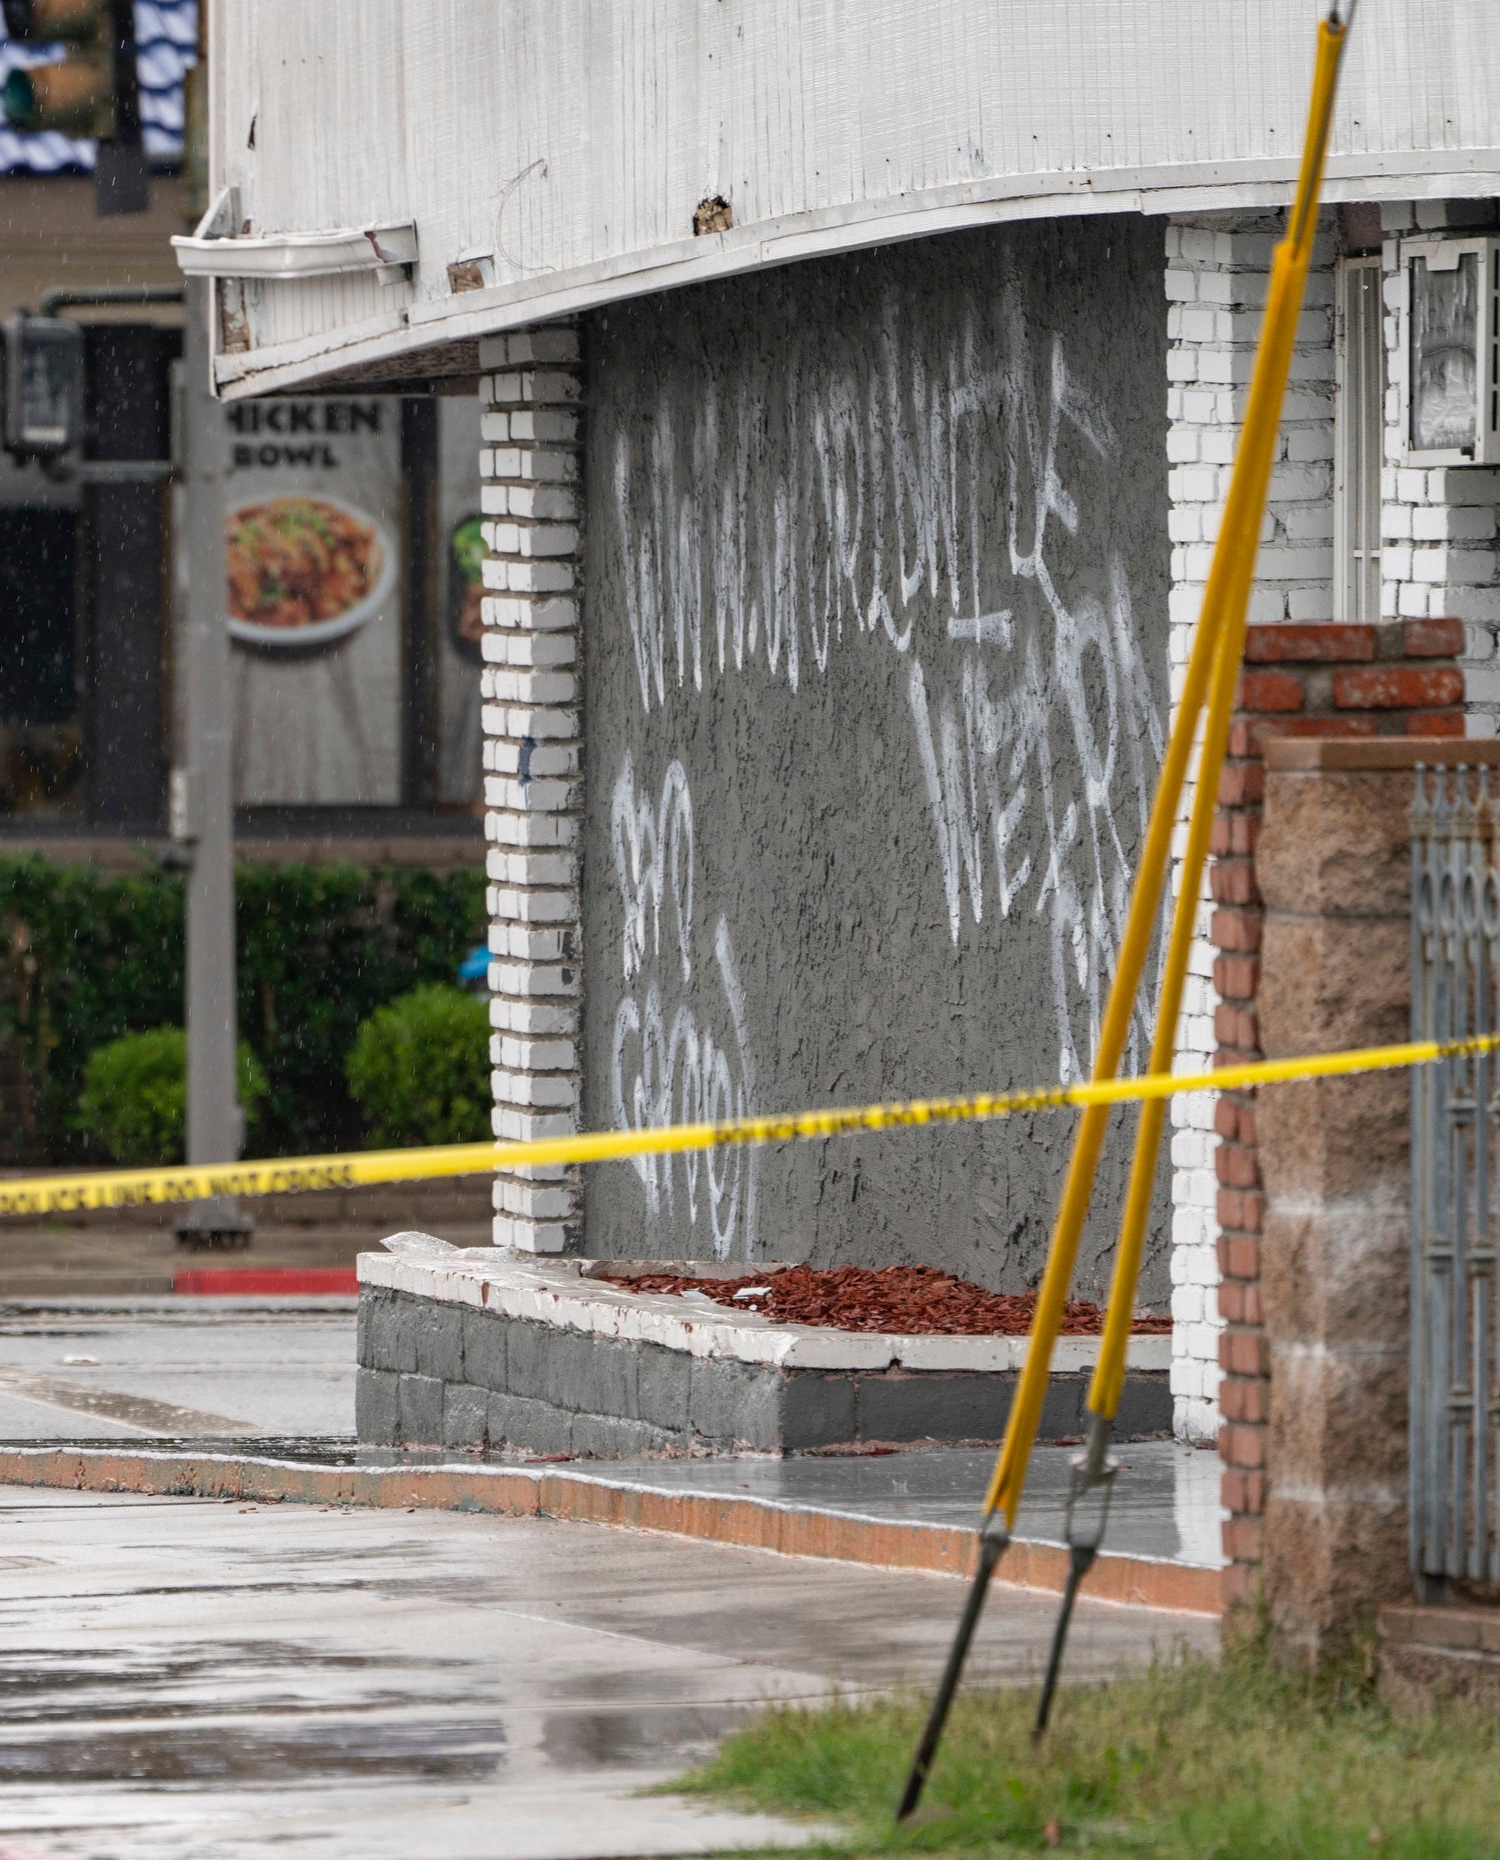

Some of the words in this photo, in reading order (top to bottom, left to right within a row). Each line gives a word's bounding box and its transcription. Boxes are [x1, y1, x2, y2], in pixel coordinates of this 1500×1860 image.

[228, 402, 380, 433] HICKEN
[233, 442, 338, 467] BOWL
[97, 1182, 152, 1206] LINE
[165, 1178, 195, 1202] DO
[210, 1171, 258, 1198] NOT
[271, 1164, 352, 1192] CROSS
